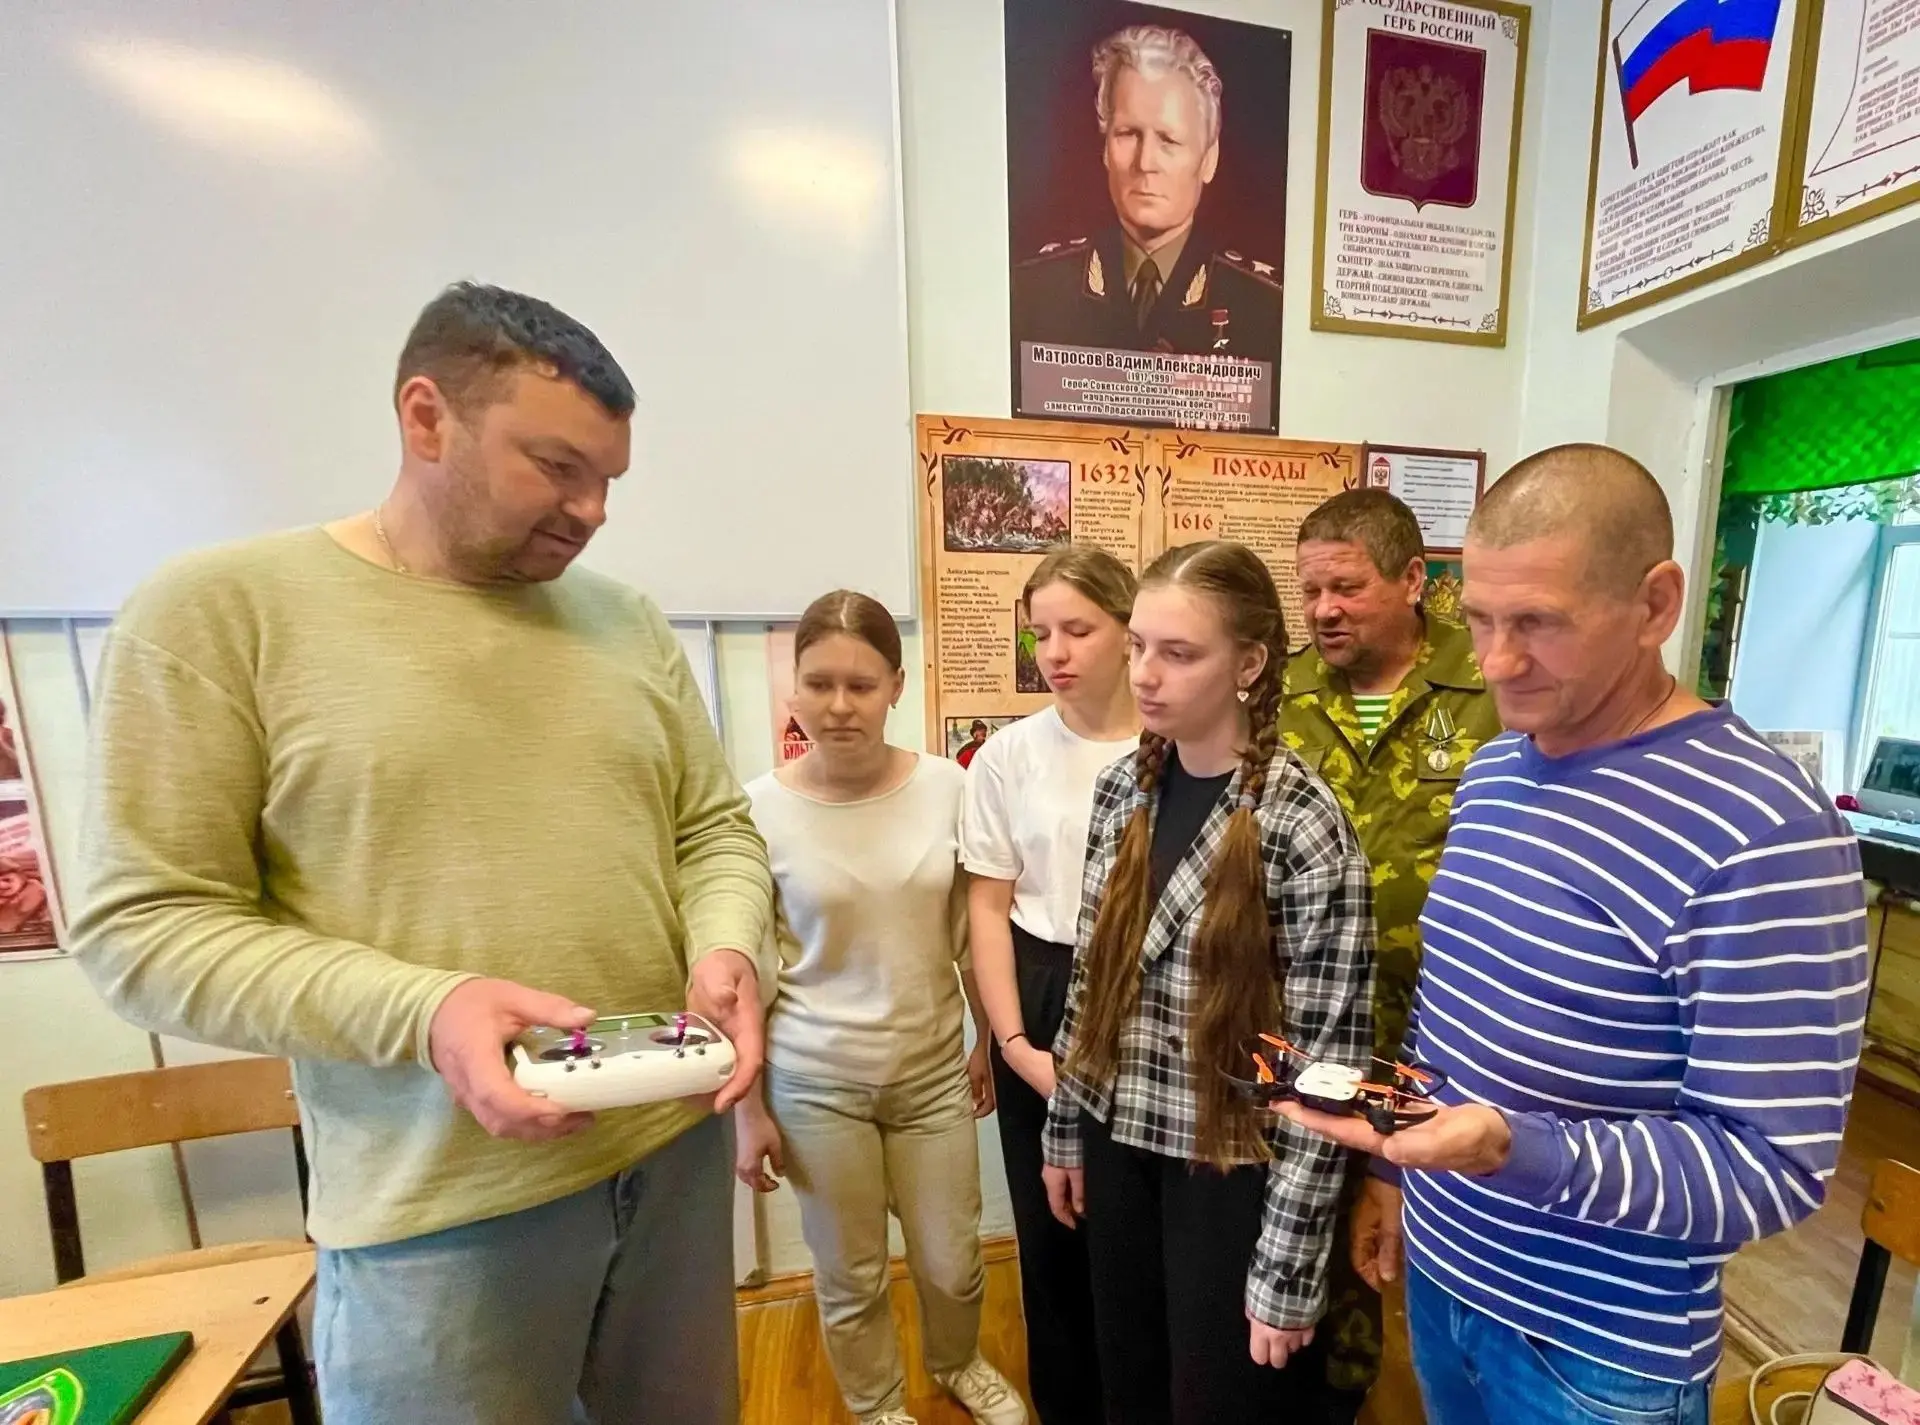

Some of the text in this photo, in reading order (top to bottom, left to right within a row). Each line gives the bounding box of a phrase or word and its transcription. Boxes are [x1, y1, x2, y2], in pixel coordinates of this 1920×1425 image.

[1383, 14, 1474, 44] ГЕРБ РОССИИ
[1725, 172, 1768, 199] ПРОСТОРОВ
[1339, 208, 1359, 221] ГЕРБ
[1339, 222, 1354, 232] ТРИ
[1355, 225, 1389, 237] КОРОНЫ
[1343, 233, 1387, 247] ГОСУДАРСТВА
[1342, 243, 1385, 256] СИБИРСКОГО
[1337, 254, 1373, 267] СКИПЕТР
[1336, 266, 1373, 279] ДЕРЖАВА
[1336, 279, 1371, 291] ГЕОРГИЙ
[1372, 284, 1427, 298] ПОБЕДОНОСЕЦ
[1033, 346, 1261, 378] Матросов Вадим Александрович
[1063, 378, 1089, 389] Герой
[1090, 380, 1139, 392] Советского
[1171, 388, 1204, 397] генерал
[1083, 392, 1214, 410] начальник пограничных войск
[1044, 401, 1103, 413] заместитель
[1104, 405, 1166, 417] Председателя
[1183, 411, 1204, 420] СССР
[1205, 411, 1250, 423] (1972-1989)
[1080, 462, 1130, 484] 1632
[1212, 457, 1306, 482] ПОХОДЫ
[1173, 512, 1213, 530] 1616
